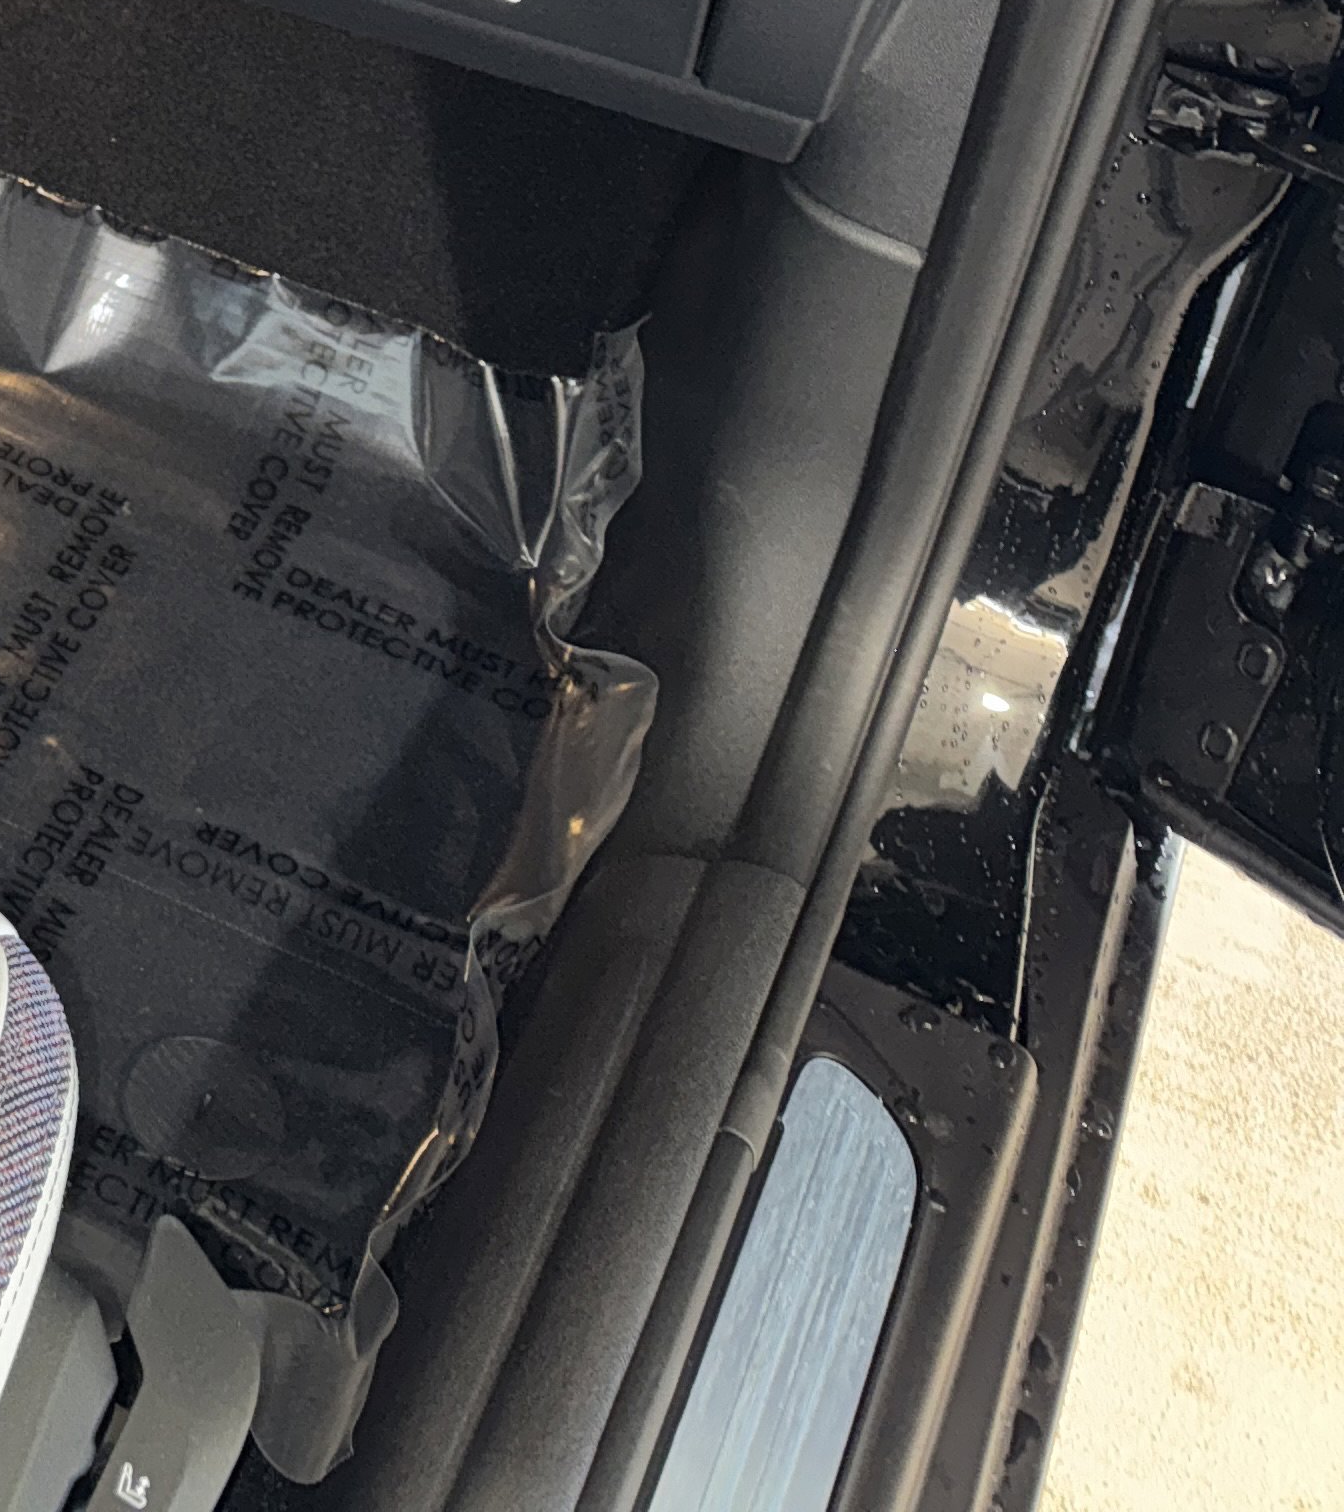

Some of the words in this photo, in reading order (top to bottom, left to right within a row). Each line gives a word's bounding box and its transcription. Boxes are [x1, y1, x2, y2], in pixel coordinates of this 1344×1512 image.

[224, 454, 290, 542] COVER
[295, 409, 352, 495] MUST
[0, 590, 59, 662] MUST
[46, 486, 130, 588] REMOVE
[65, 545, 139, 640] COVER
[232, 506, 313, 601] REMOVE
[268, 588, 481, 692] PROTECTIVE
[286, 566, 417, 634] DEALER
[424, 627, 518, 681] MUST
[70, 783, 145, 889] DEALER
[121, 818, 293, 919] REMOVE
[195, 819, 331, 891] COVER
[316, 907, 400, 966] MUST
[145, 1160, 254, 1224] MUST
